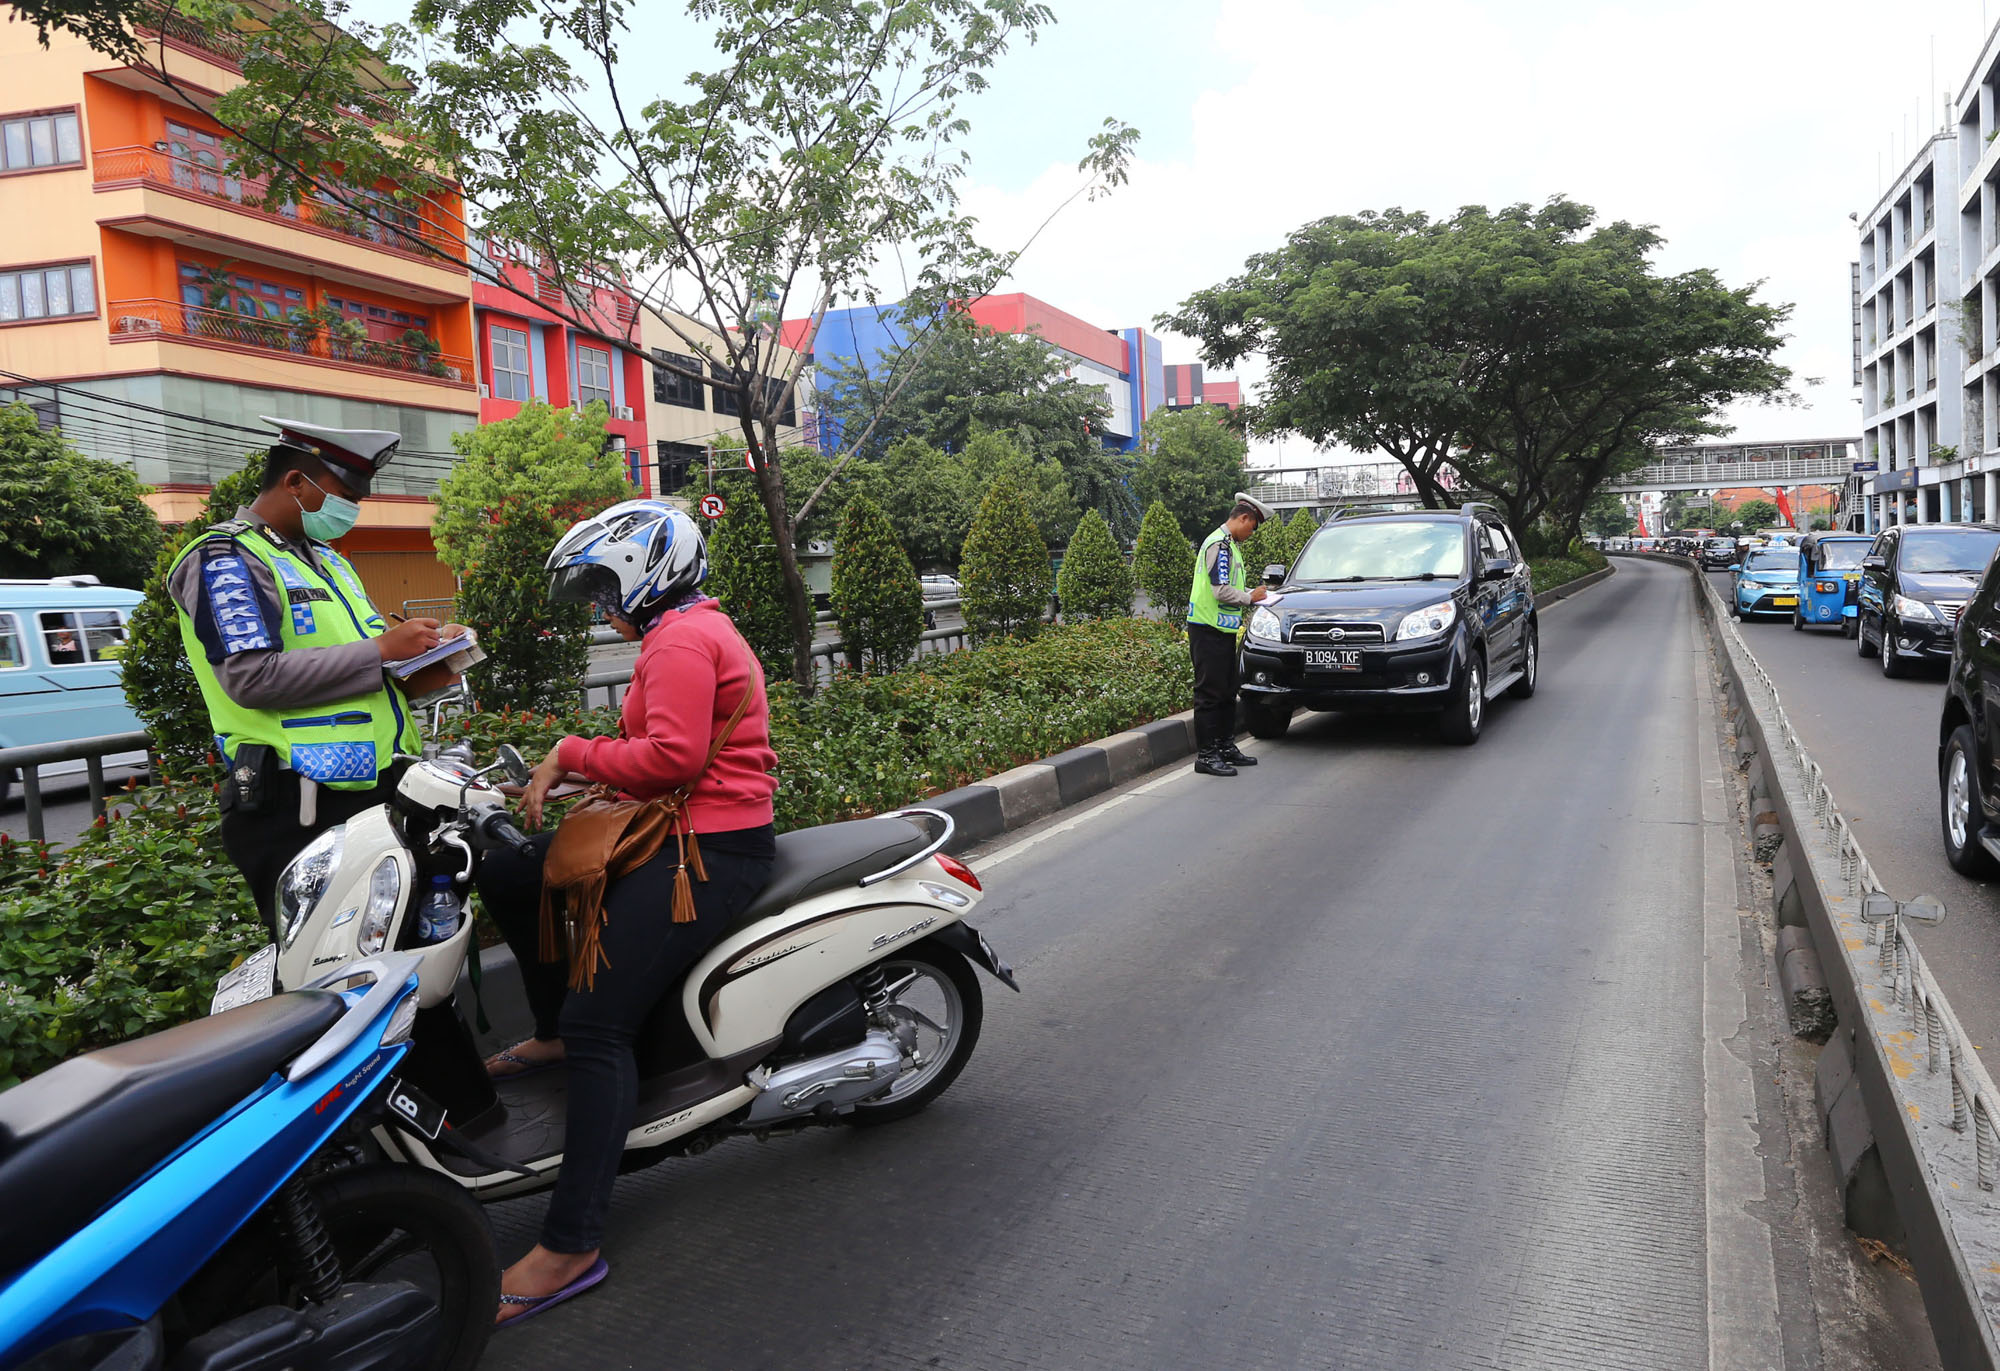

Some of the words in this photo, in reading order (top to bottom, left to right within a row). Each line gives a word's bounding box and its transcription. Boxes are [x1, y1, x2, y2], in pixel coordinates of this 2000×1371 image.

[205, 557, 268, 654] GAKKUM
[1306, 651, 1313, 663] B
[1314, 651, 1338, 663] 1094
[1340, 651, 1360, 663] TKF
[867, 915, 938, 952] Scoopy
[245, 948, 270, 966] B
[746, 944, 798, 965] Stylish
[395, 1094, 419, 1118] B
